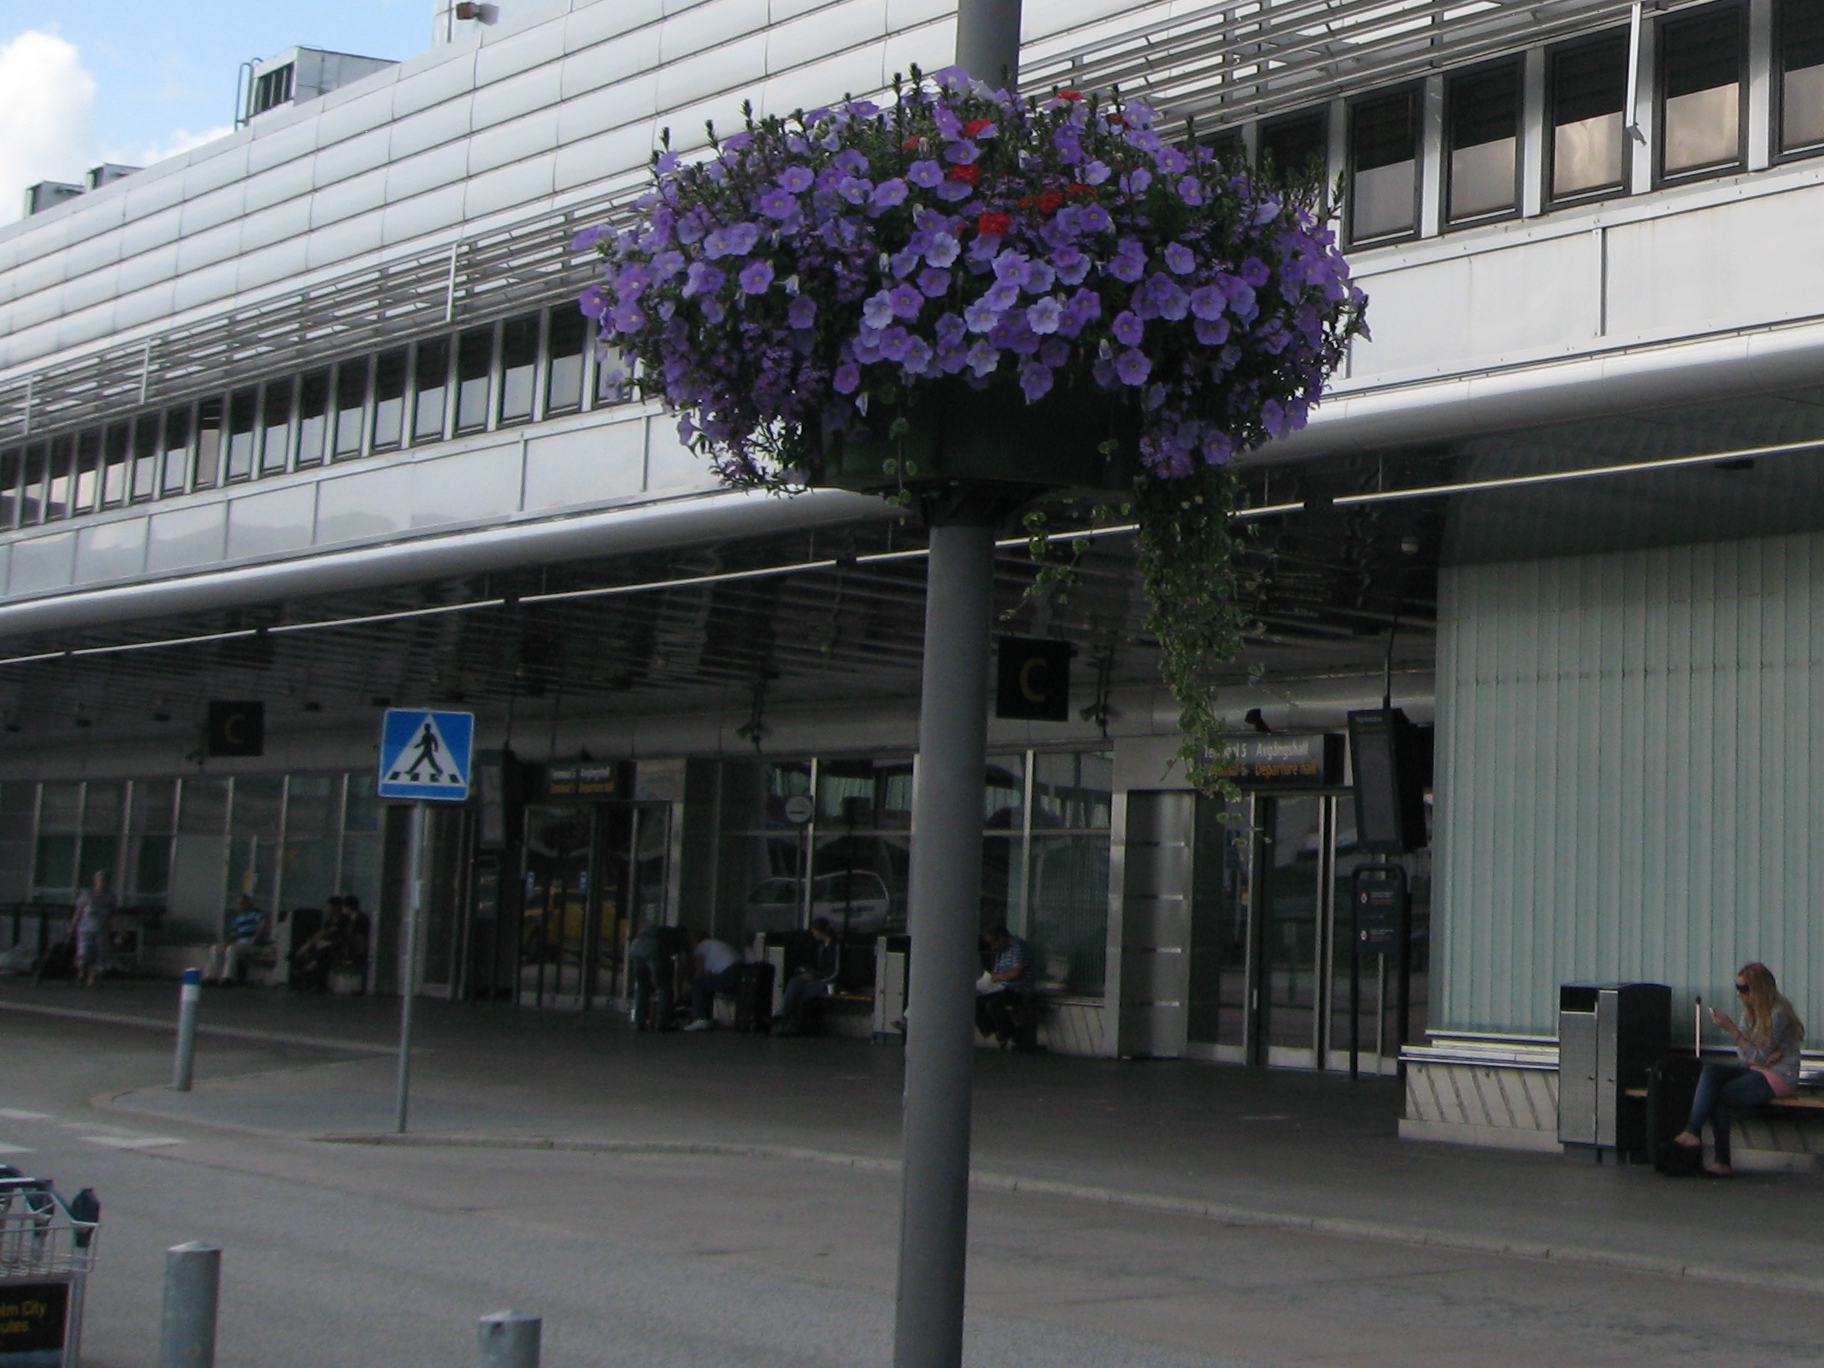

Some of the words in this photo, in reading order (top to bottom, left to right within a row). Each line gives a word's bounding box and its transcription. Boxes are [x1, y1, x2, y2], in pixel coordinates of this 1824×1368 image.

[1020, 657, 1047, 702] C
[224, 714, 246, 744] C
[1240, 742, 1248, 759] 5
